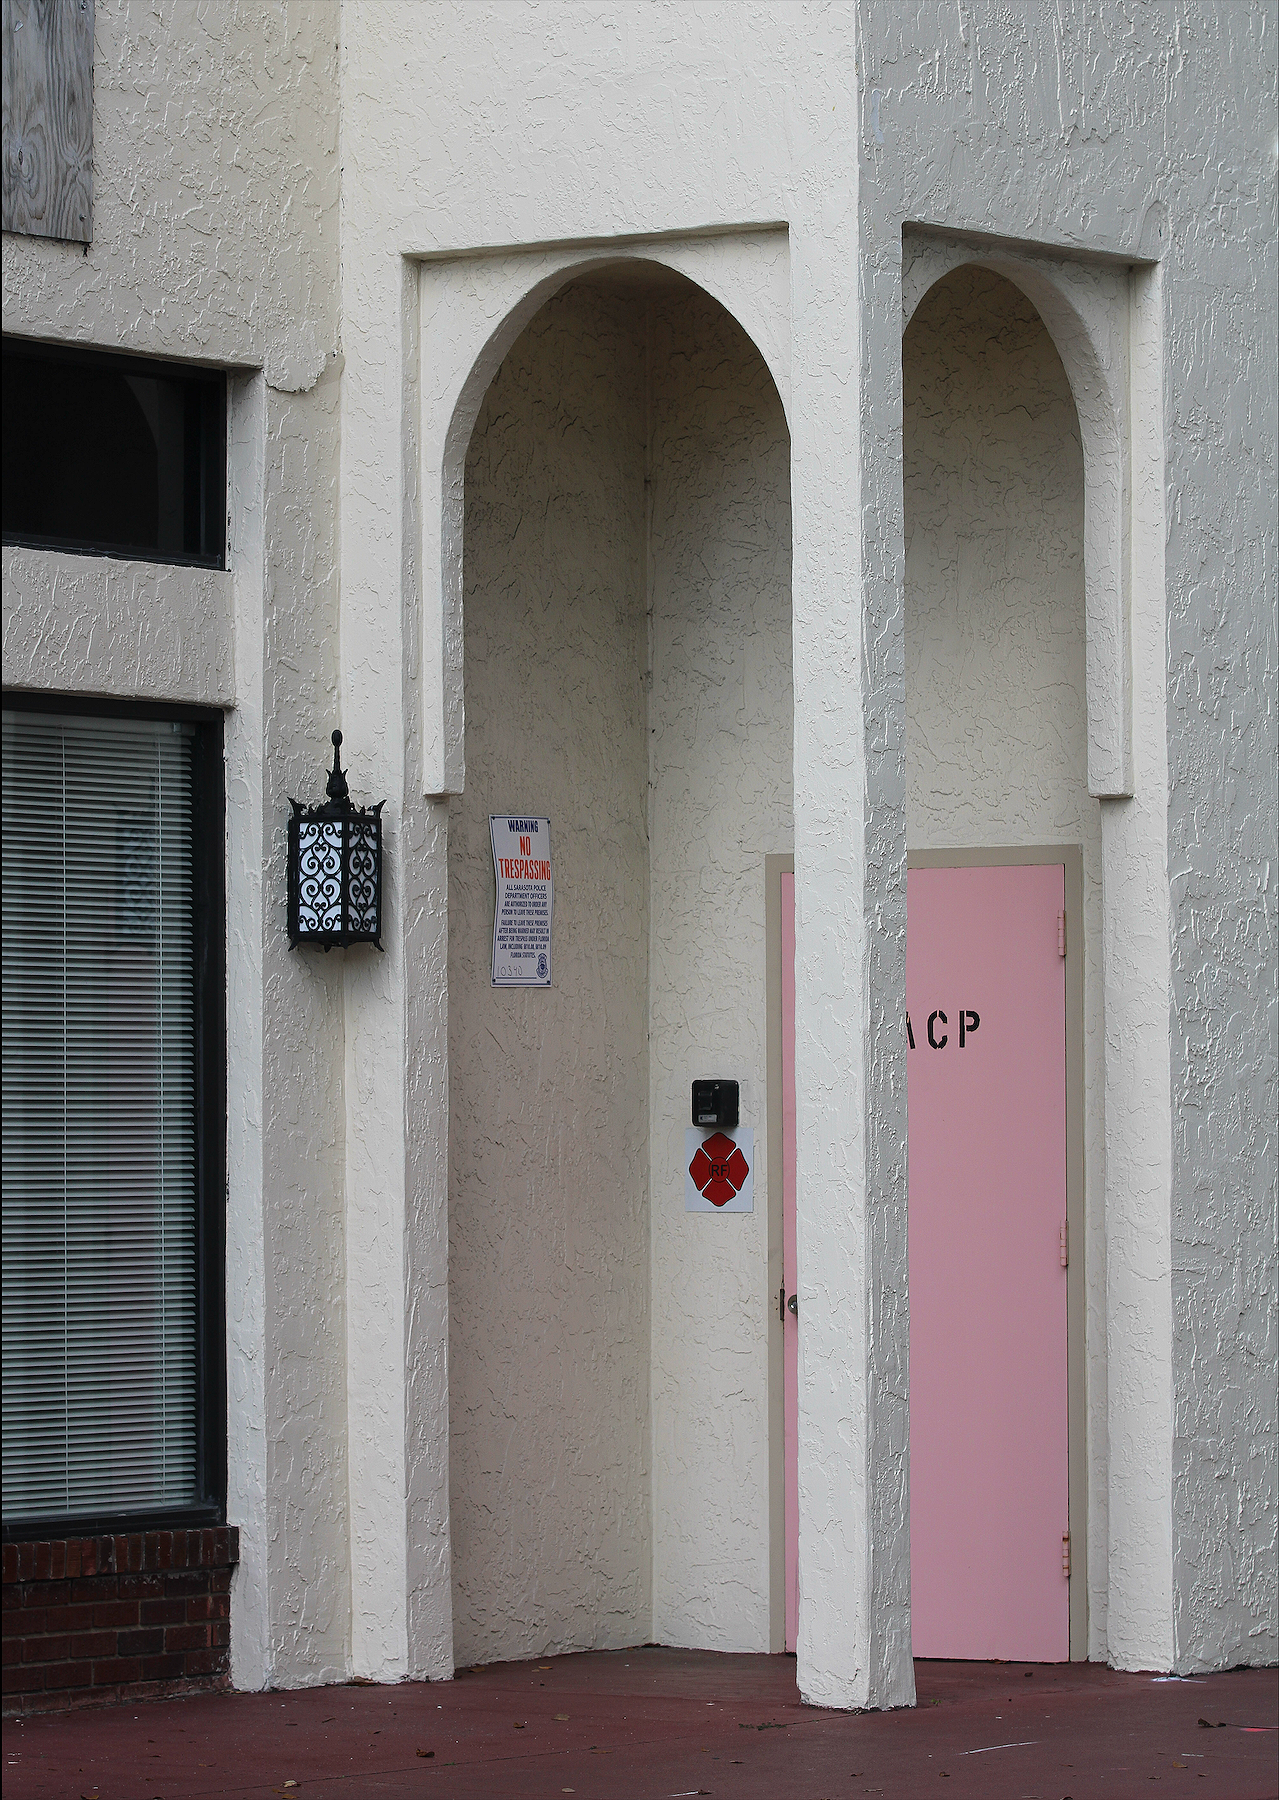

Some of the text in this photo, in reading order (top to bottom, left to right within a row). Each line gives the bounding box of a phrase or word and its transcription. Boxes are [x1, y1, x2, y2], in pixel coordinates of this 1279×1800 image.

[508, 820, 538, 832] WARNING
[520, 836, 531, 856] NO
[498, 858, 550, 880] TRESPASSING
[711, 1164, 728, 1176] RF
